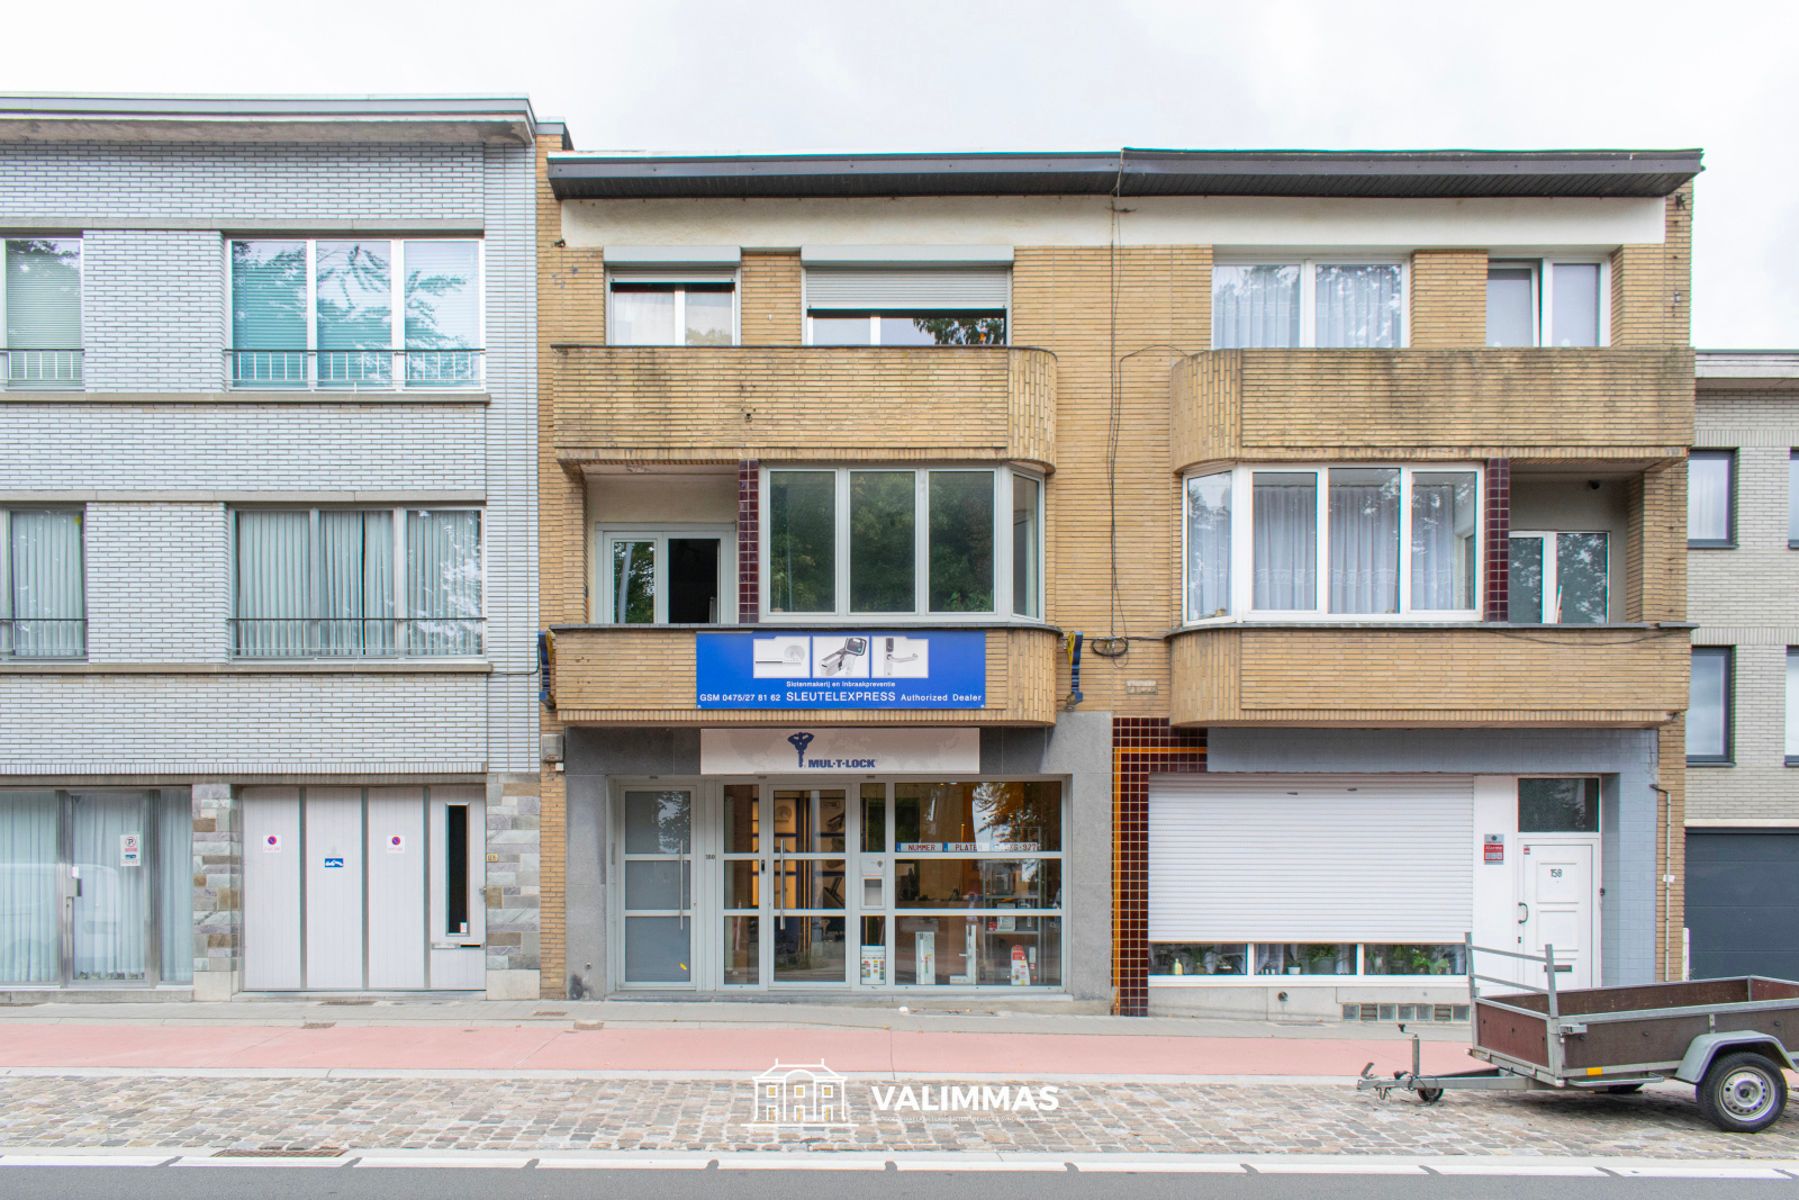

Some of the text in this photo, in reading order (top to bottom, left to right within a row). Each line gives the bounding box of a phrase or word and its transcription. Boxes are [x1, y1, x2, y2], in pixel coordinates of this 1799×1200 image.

[699, 691, 982, 702] GSM 0475/27 81 62 SLEUTELEXPRESS Authorized Dealer
[907, 844, 936, 852] NUMMER
